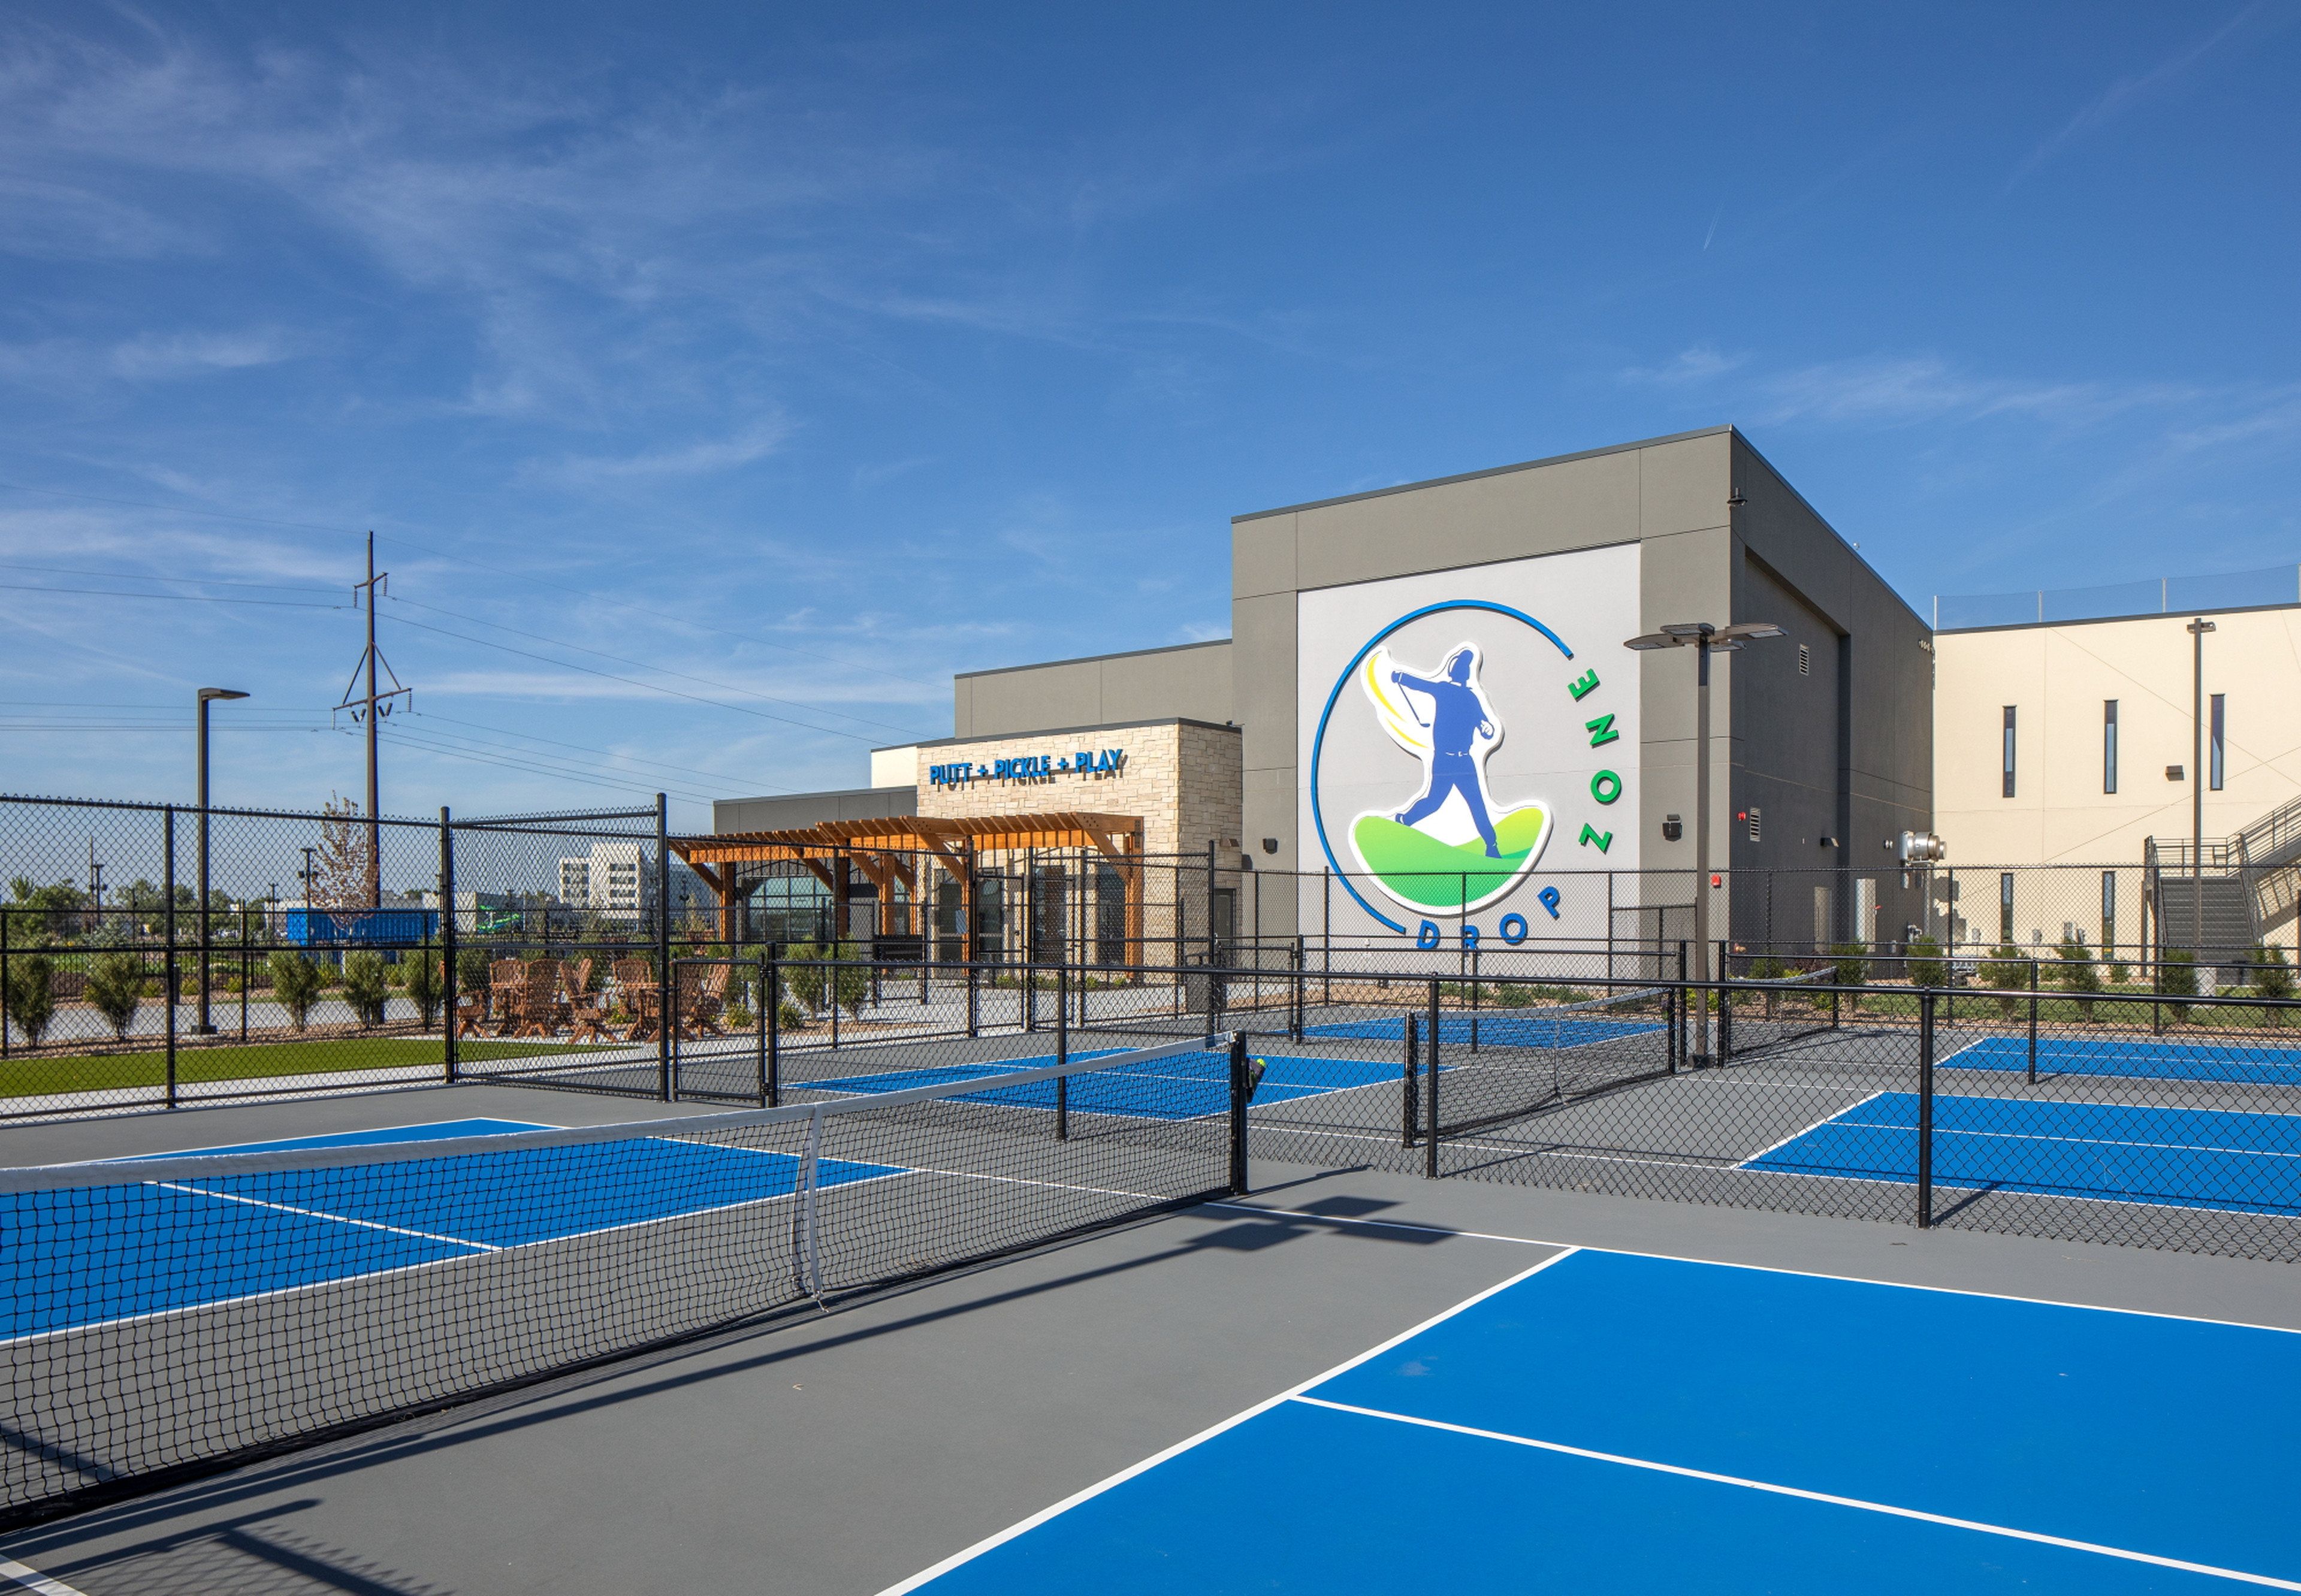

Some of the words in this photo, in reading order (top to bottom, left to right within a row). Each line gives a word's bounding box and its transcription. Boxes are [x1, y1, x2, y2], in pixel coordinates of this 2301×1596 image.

[930, 763, 973, 785] PUTT
[992, 755, 1050, 779] PICKLE
[1074, 749, 1122, 773] PLAY
[1416, 886, 1560, 954] DROP
[1568, 669, 1621, 854] ZONE
